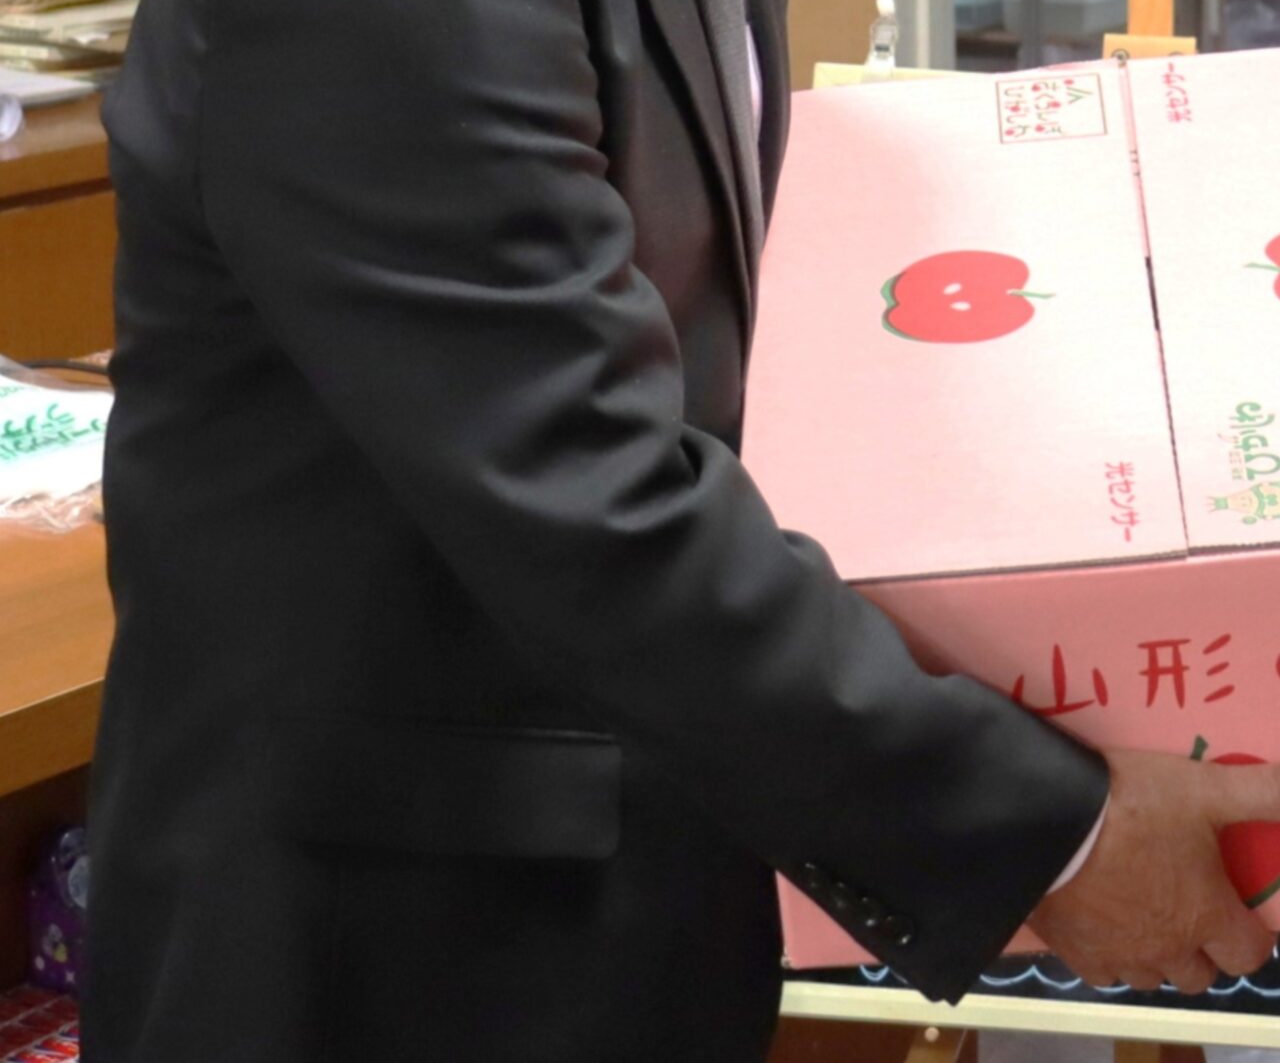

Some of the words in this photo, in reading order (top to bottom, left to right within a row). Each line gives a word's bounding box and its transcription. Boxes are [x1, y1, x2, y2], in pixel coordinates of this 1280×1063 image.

[1104, 461, 1140, 542] 光センサー
